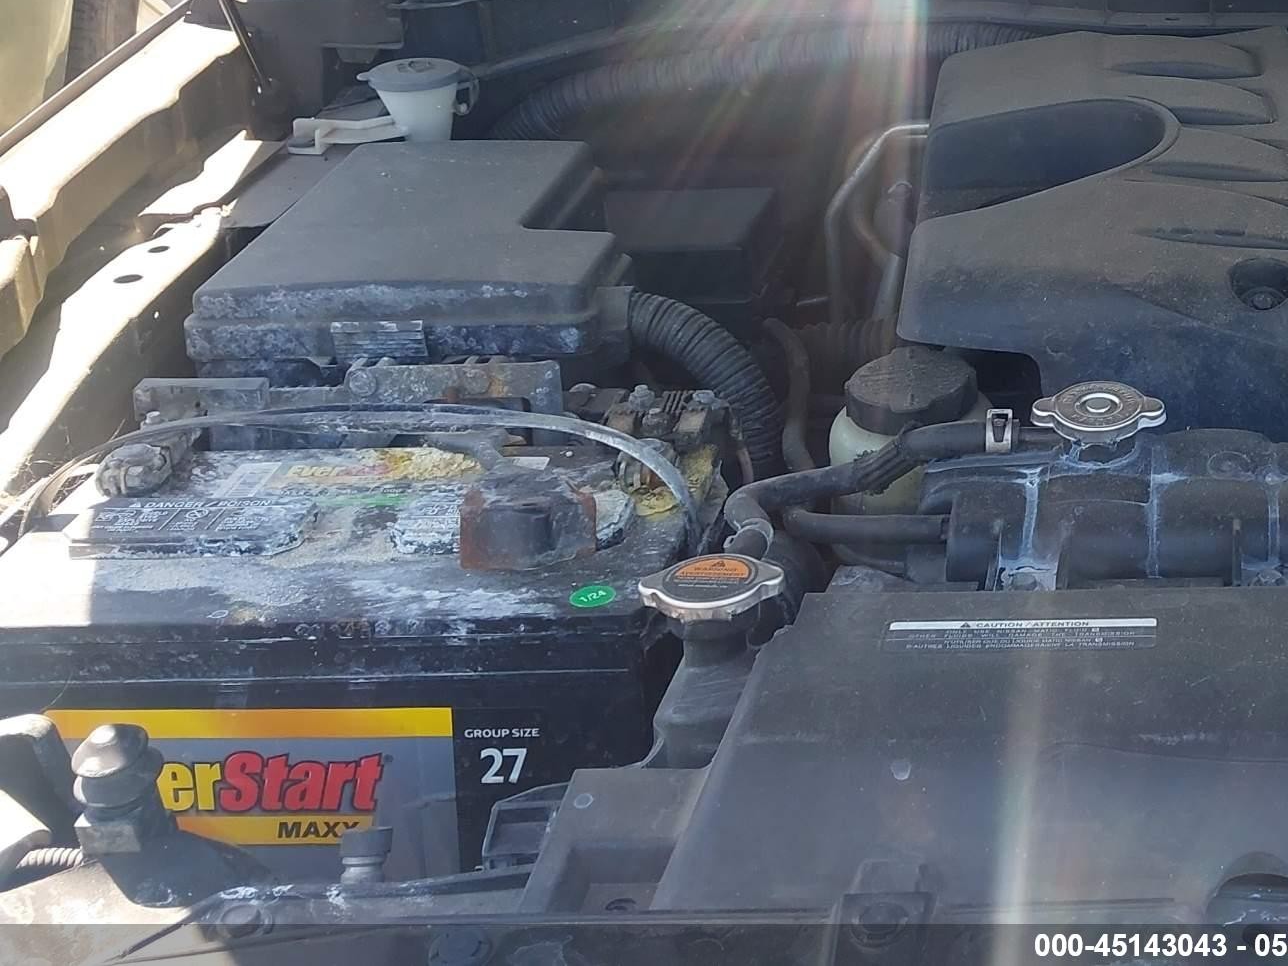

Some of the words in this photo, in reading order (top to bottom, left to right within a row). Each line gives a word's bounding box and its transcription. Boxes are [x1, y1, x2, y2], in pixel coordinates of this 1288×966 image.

[464, 728, 510, 738] GROUP
[511, 727, 540, 738] SIZE
[480, 747, 527, 784] 27
